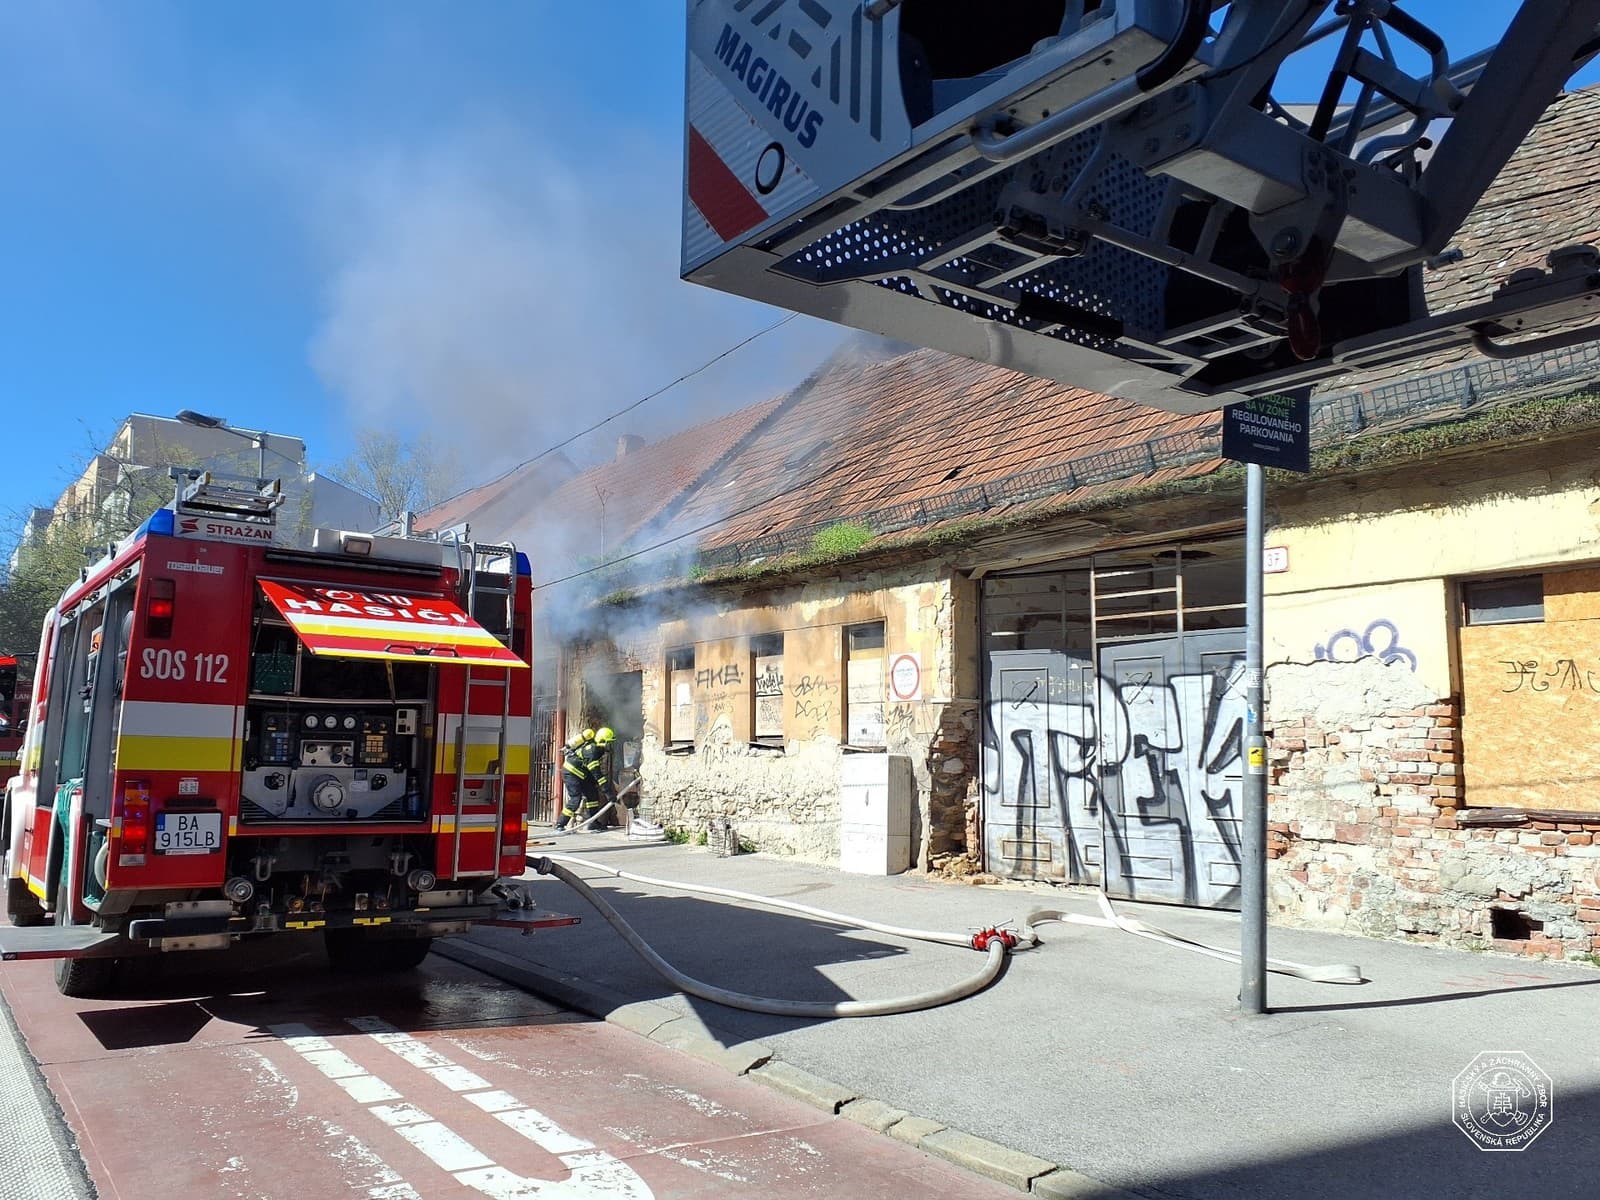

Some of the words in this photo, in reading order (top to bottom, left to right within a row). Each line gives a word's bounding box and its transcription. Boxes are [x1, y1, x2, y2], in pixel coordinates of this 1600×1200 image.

[715, 23, 824, 149] MAGIRUS
[1245, 401, 1257, 411] SA
[1258, 403, 1266, 412] V
[1267, 405, 1290, 418] ZÓNE
[1231, 409, 1302, 433] REGULOVANÉHO
[1239, 423, 1295, 444] PARKOVANIA
[206, 524, 272, 539] STRAŽAN
[167, 559, 225, 574] rosenbauer
[286, 598, 468, 624] HASIČI
[140, 648, 187, 680] SOS
[194, 653, 229, 683] 112
[178, 815, 199, 831] BA
[161, 831, 215, 848] 915LB
